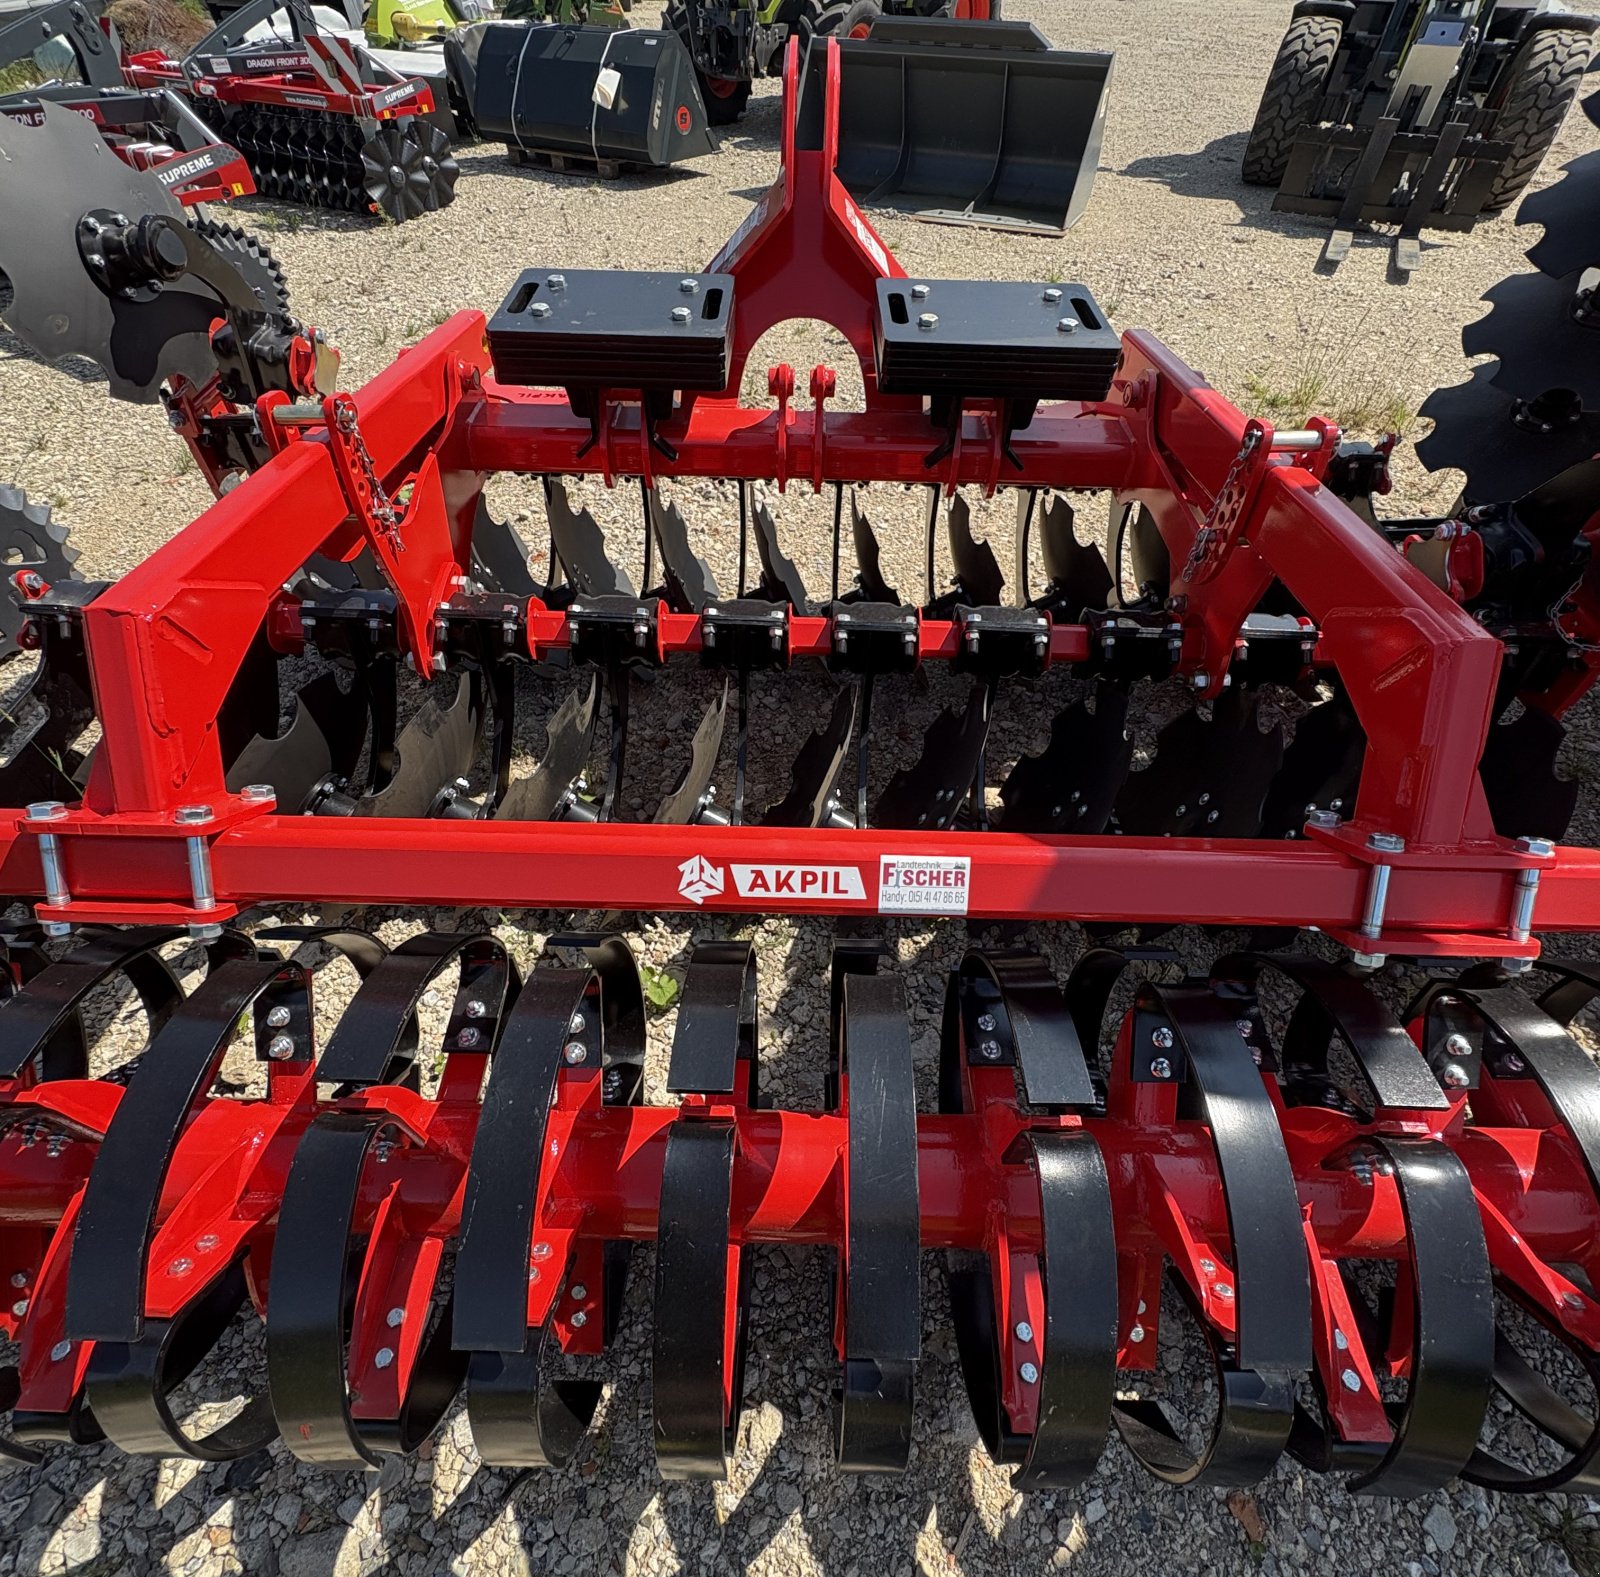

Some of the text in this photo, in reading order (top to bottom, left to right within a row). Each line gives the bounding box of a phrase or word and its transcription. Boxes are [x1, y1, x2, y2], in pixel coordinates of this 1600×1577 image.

[246, 58, 275, 68] DRAGON
[276, 57, 299, 66] FRONT
[384, 84, 415, 104] SUPREME
[158, 153, 214, 186] SUPREME
[896, 860, 942, 870] Landtechnik
[747, 869, 849, 895] AKPIL
[881, 890, 965, 905] Handy: 0151 41 47 86 65
